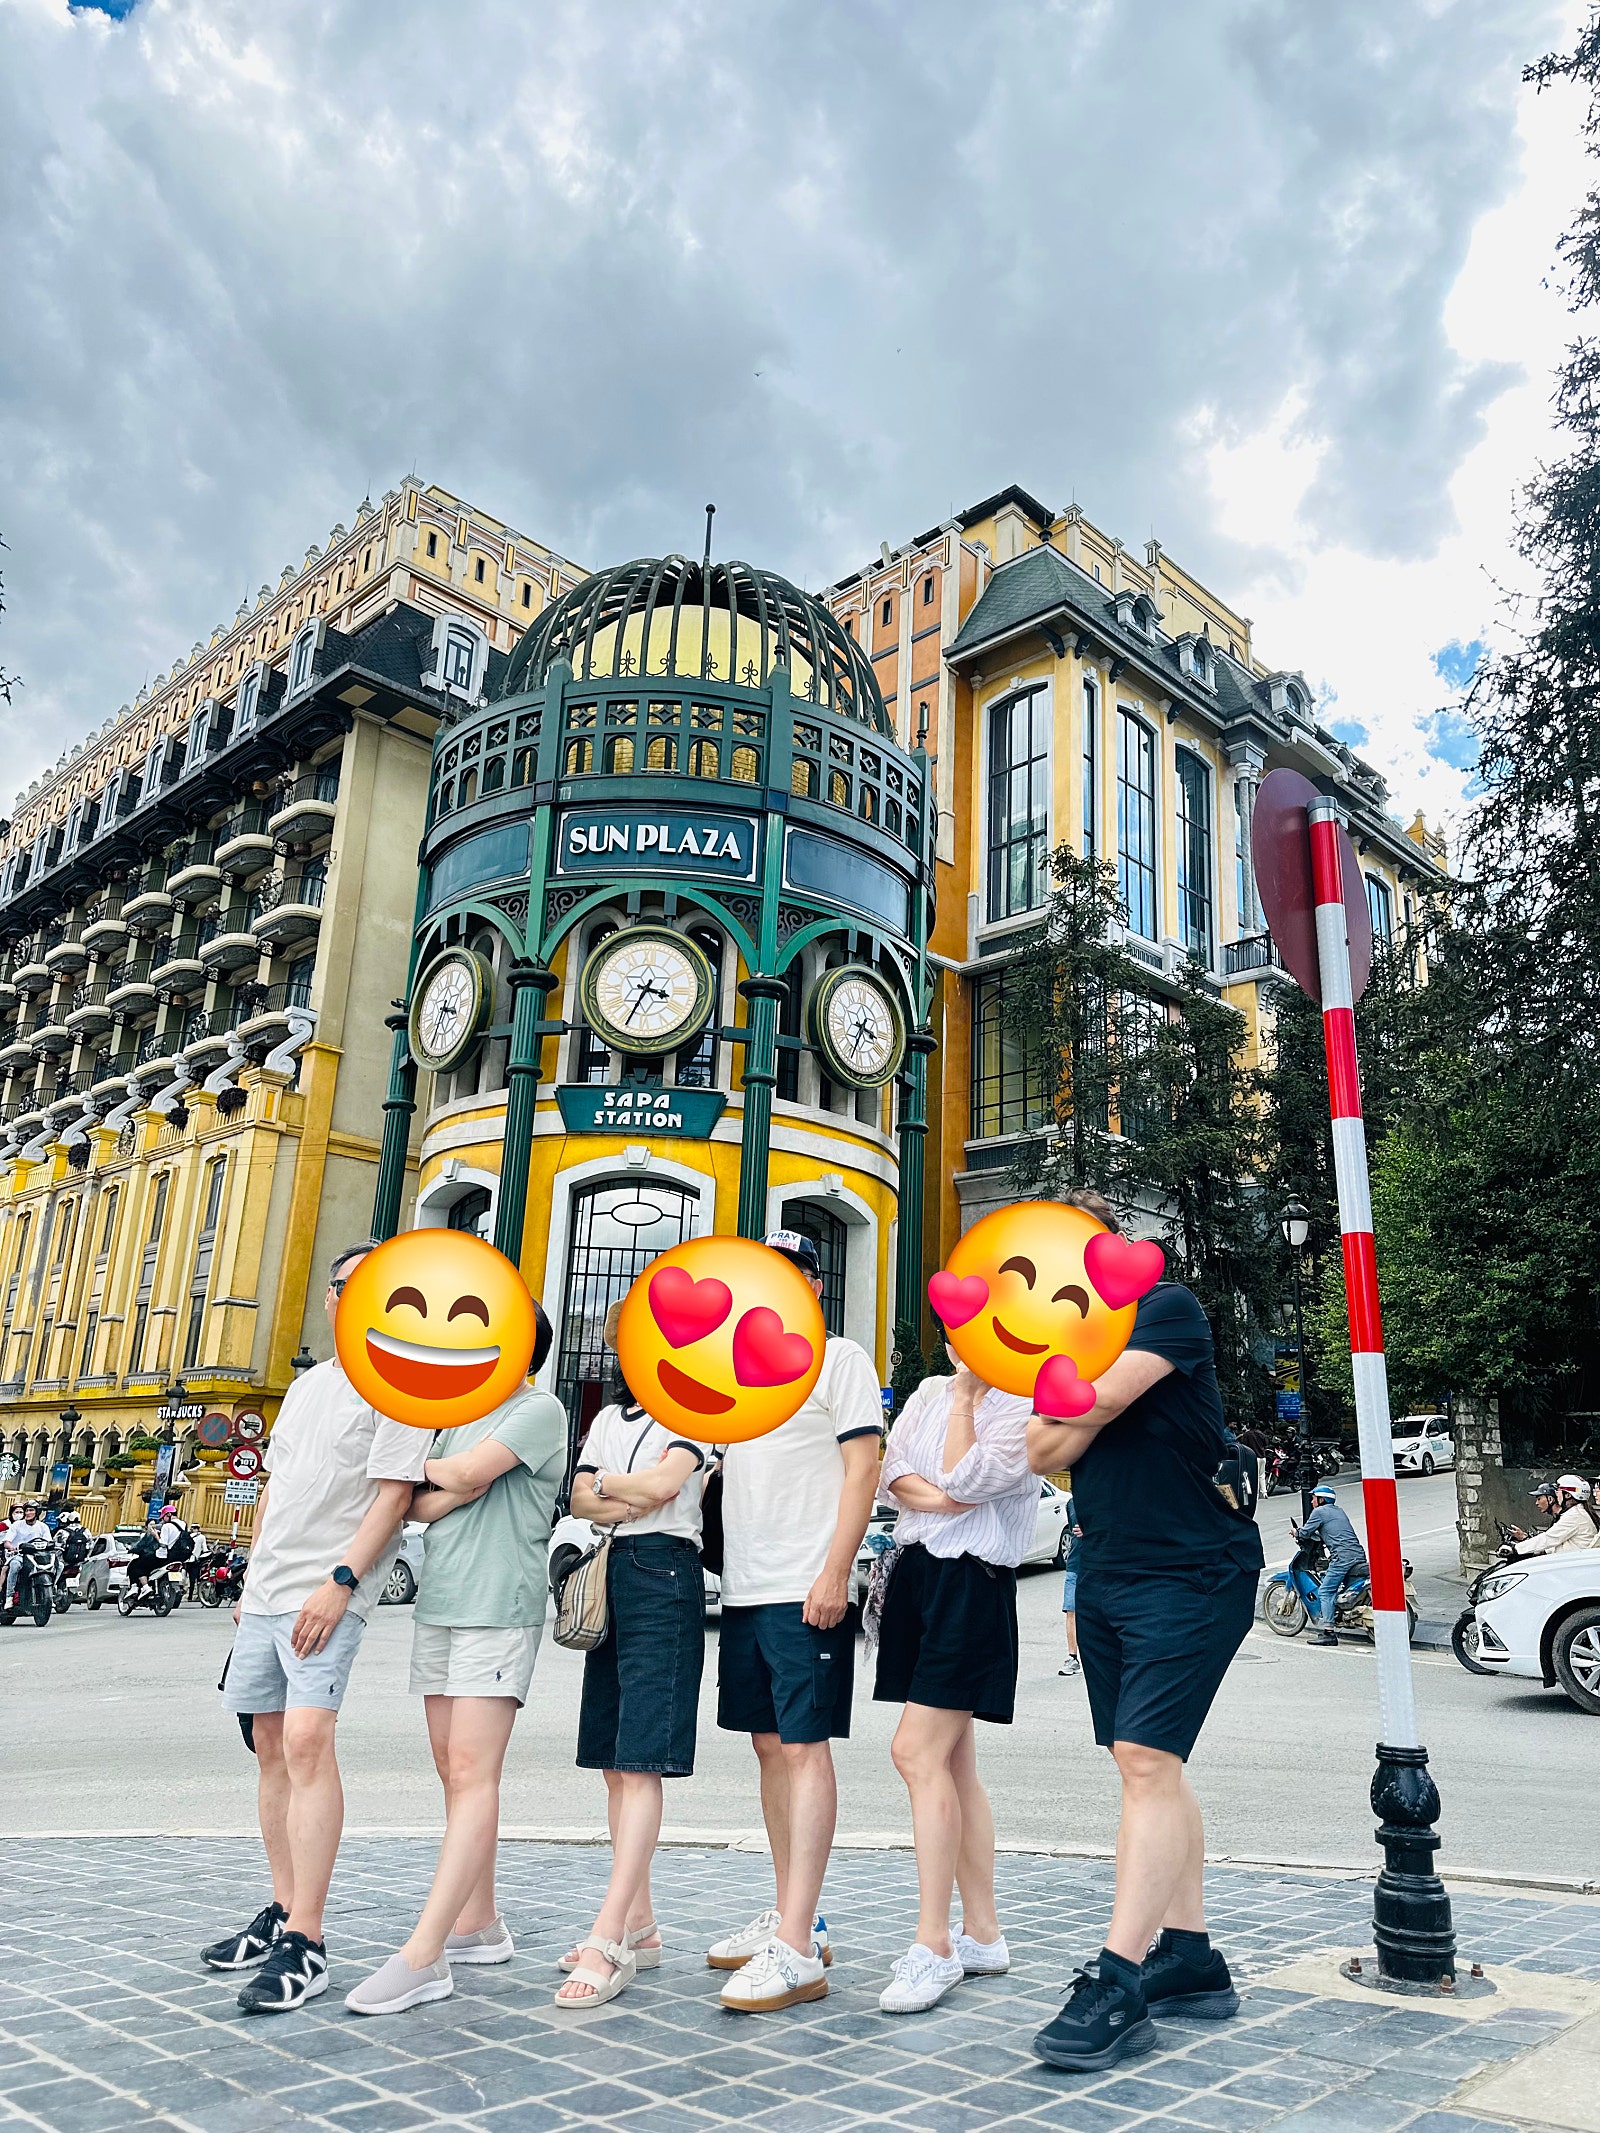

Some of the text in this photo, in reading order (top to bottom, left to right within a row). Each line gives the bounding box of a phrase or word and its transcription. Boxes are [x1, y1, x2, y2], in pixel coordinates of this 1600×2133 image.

[569, 825, 741, 860] SUN PLAZA
[604, 1092, 670, 1109] SAPA
[594, 1110, 682, 1128] STATION
[770, 1232, 798, 1241] PRAY
